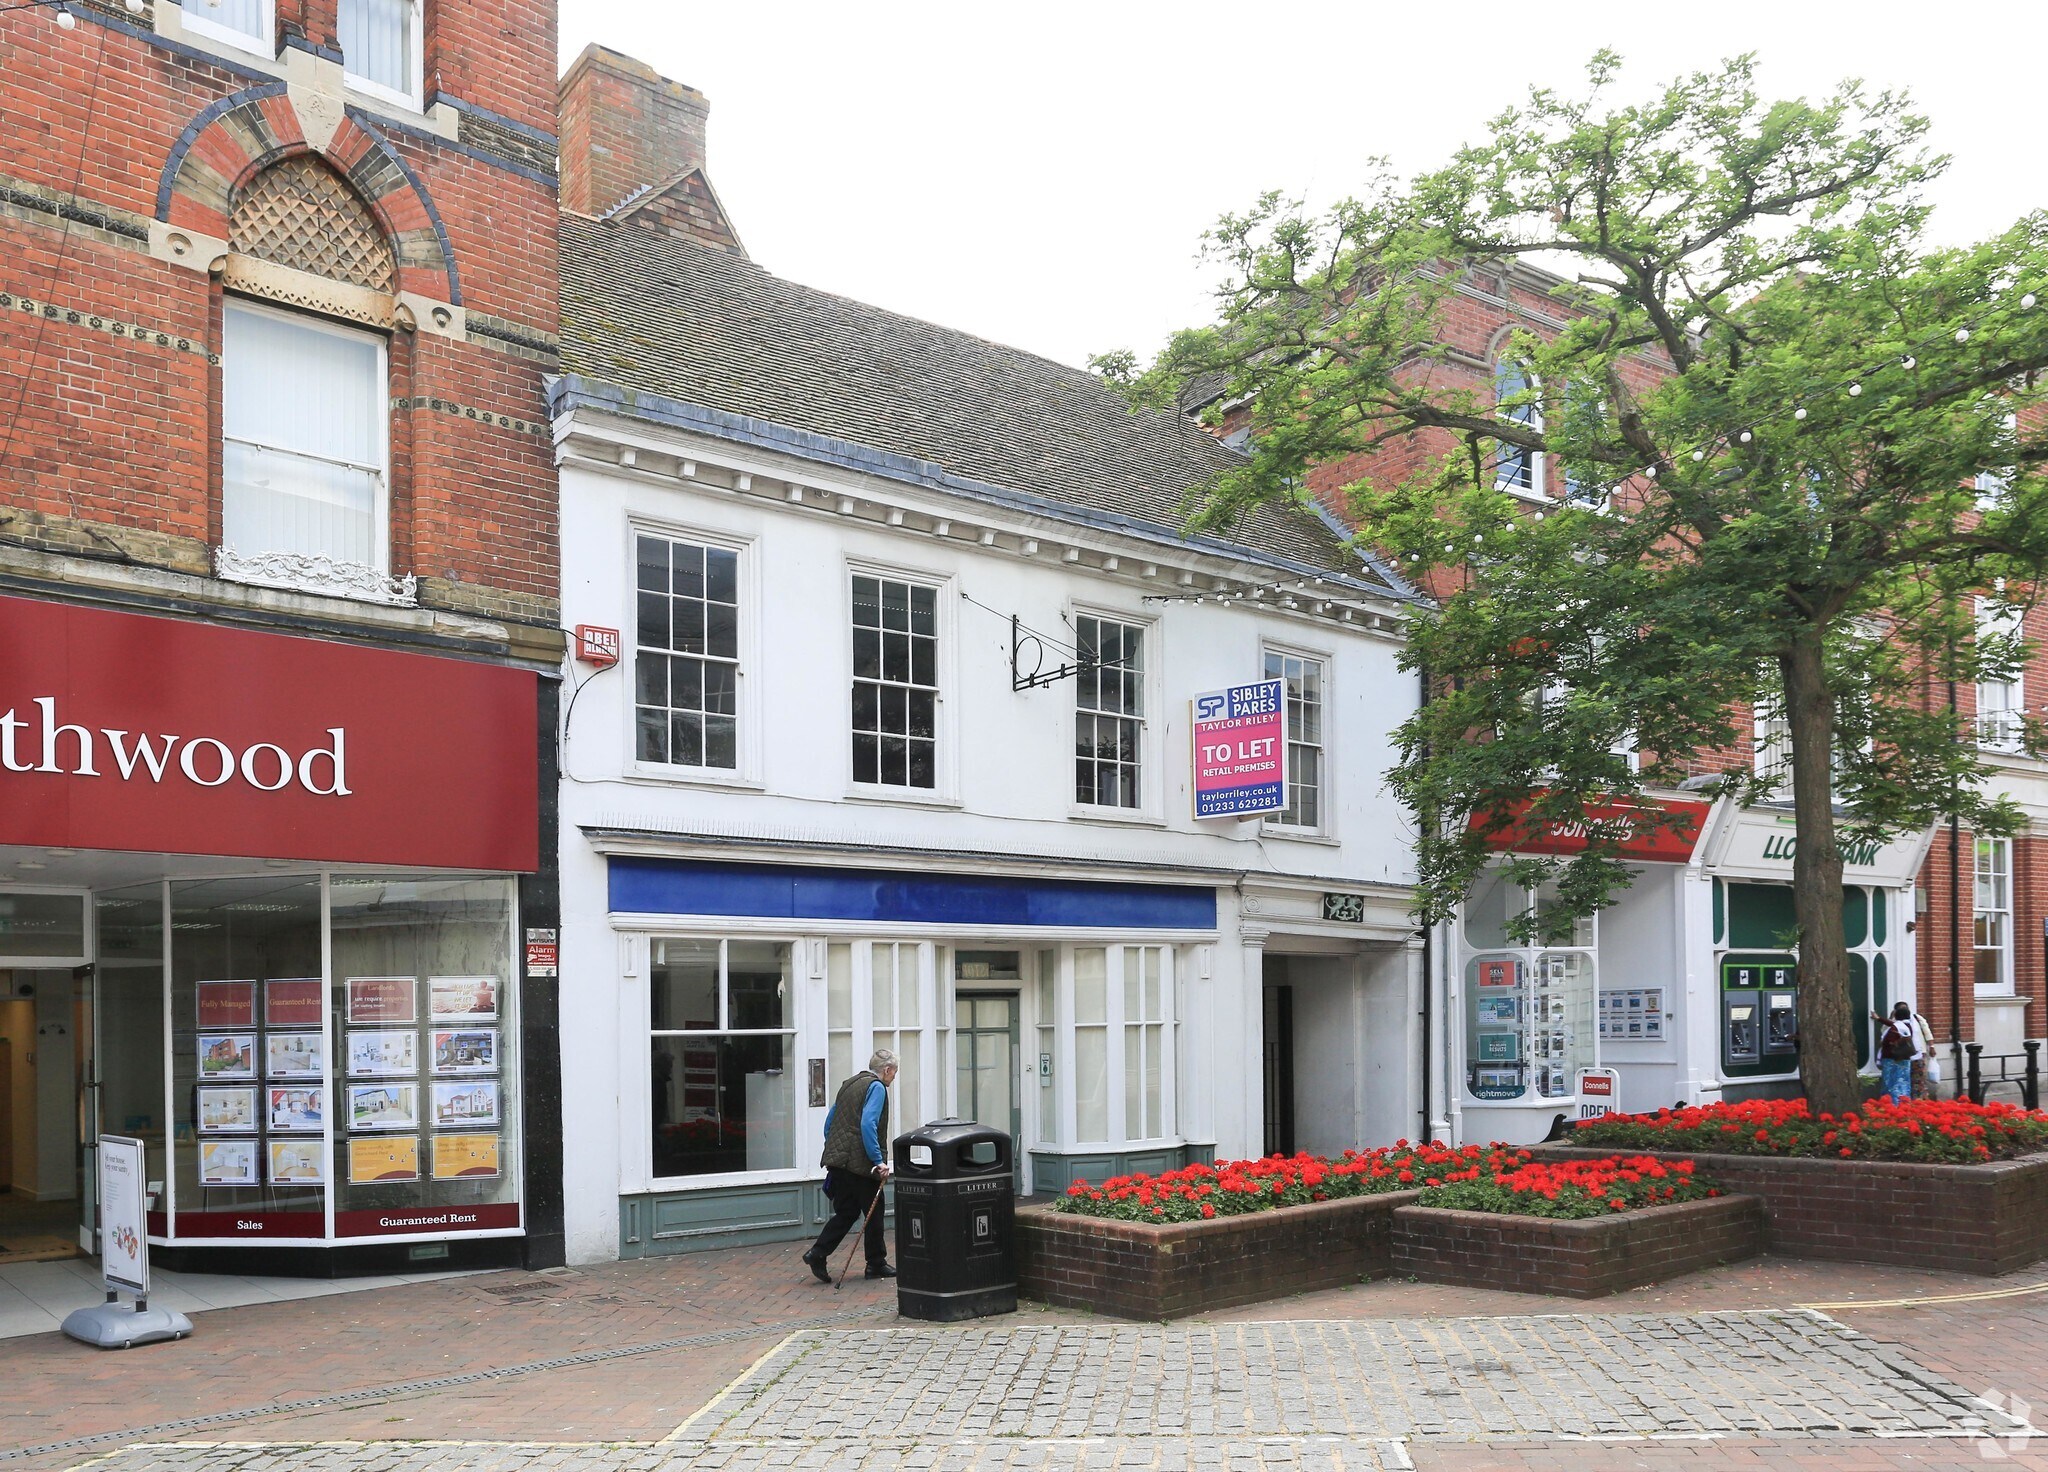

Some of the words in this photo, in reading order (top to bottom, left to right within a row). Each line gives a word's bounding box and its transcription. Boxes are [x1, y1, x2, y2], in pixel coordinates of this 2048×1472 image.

[585, 630, 616, 647] ABEL
[1231, 683, 1277, 703] SIBLEY
[1233, 698, 1276, 717] PARES
[1201, 720, 1242, 732] TAYLOR
[1245, 713, 1275, 726] RILEY
[1202, 743, 1232, 764] TO
[1238, 737, 1276, 760] LET
[1203, 766, 1233, 778] RETAIL
[1234, 760, 1276, 774] PREMISES
[1201, 785, 1278, 802] taylorriley.co.uk
[1202, 801, 1235, 813] 01233
[1238, 796, 1278, 809] 629281
[528, 945, 556, 954] Alarm
[220, 1000, 251, 1010] Managed
[269, 998, 306, 1007] Guaranteed
[1584, 1081, 1610, 1090] Connells
[1475, 1089, 1516, 1099] rightmove
[902, 1185, 925, 1195] LITTER
[966, 1182, 998, 1192] LITTER
[237, 1220, 263, 1230] Sales
[379, 1214, 447, 1227] Guaranteed
[449, 1213, 477, 1223] Rent
